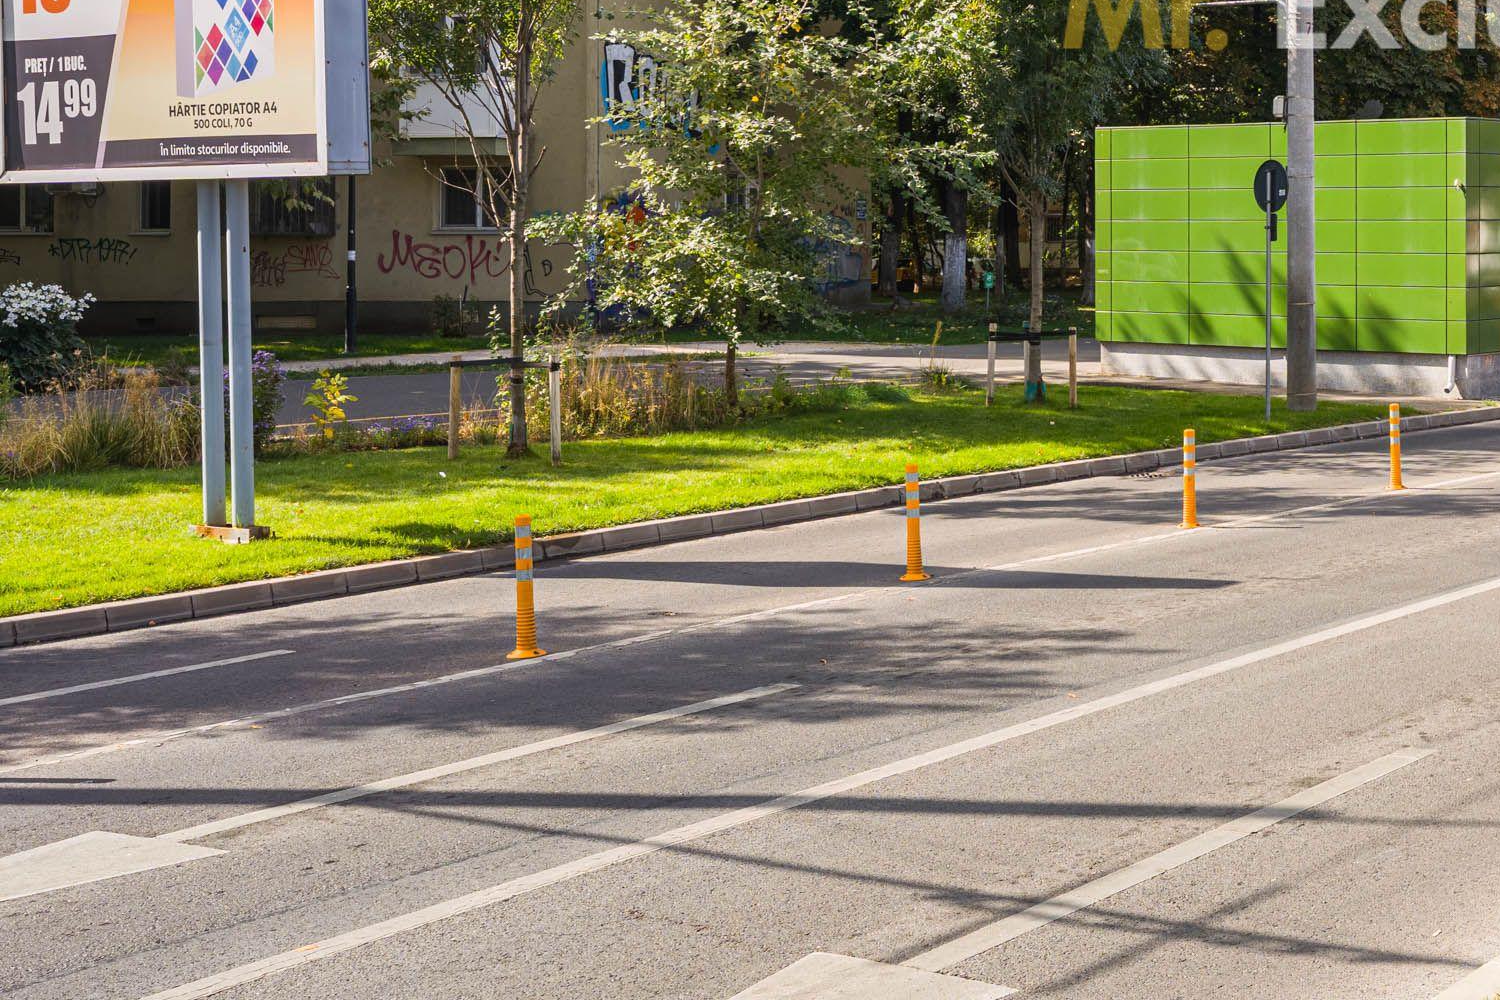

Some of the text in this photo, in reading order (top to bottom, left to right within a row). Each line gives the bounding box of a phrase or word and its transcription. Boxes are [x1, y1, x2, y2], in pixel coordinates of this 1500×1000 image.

[57, 56, 63, 72] 1
[64, 55, 86, 71] BUC.
[169, 101, 277, 117] HÂRTIE COPIATOR A4
[194, 117, 253, 129] 500 COLI, 70 G
[160, 142, 291, 156] În limita stocurilor disponibile.
